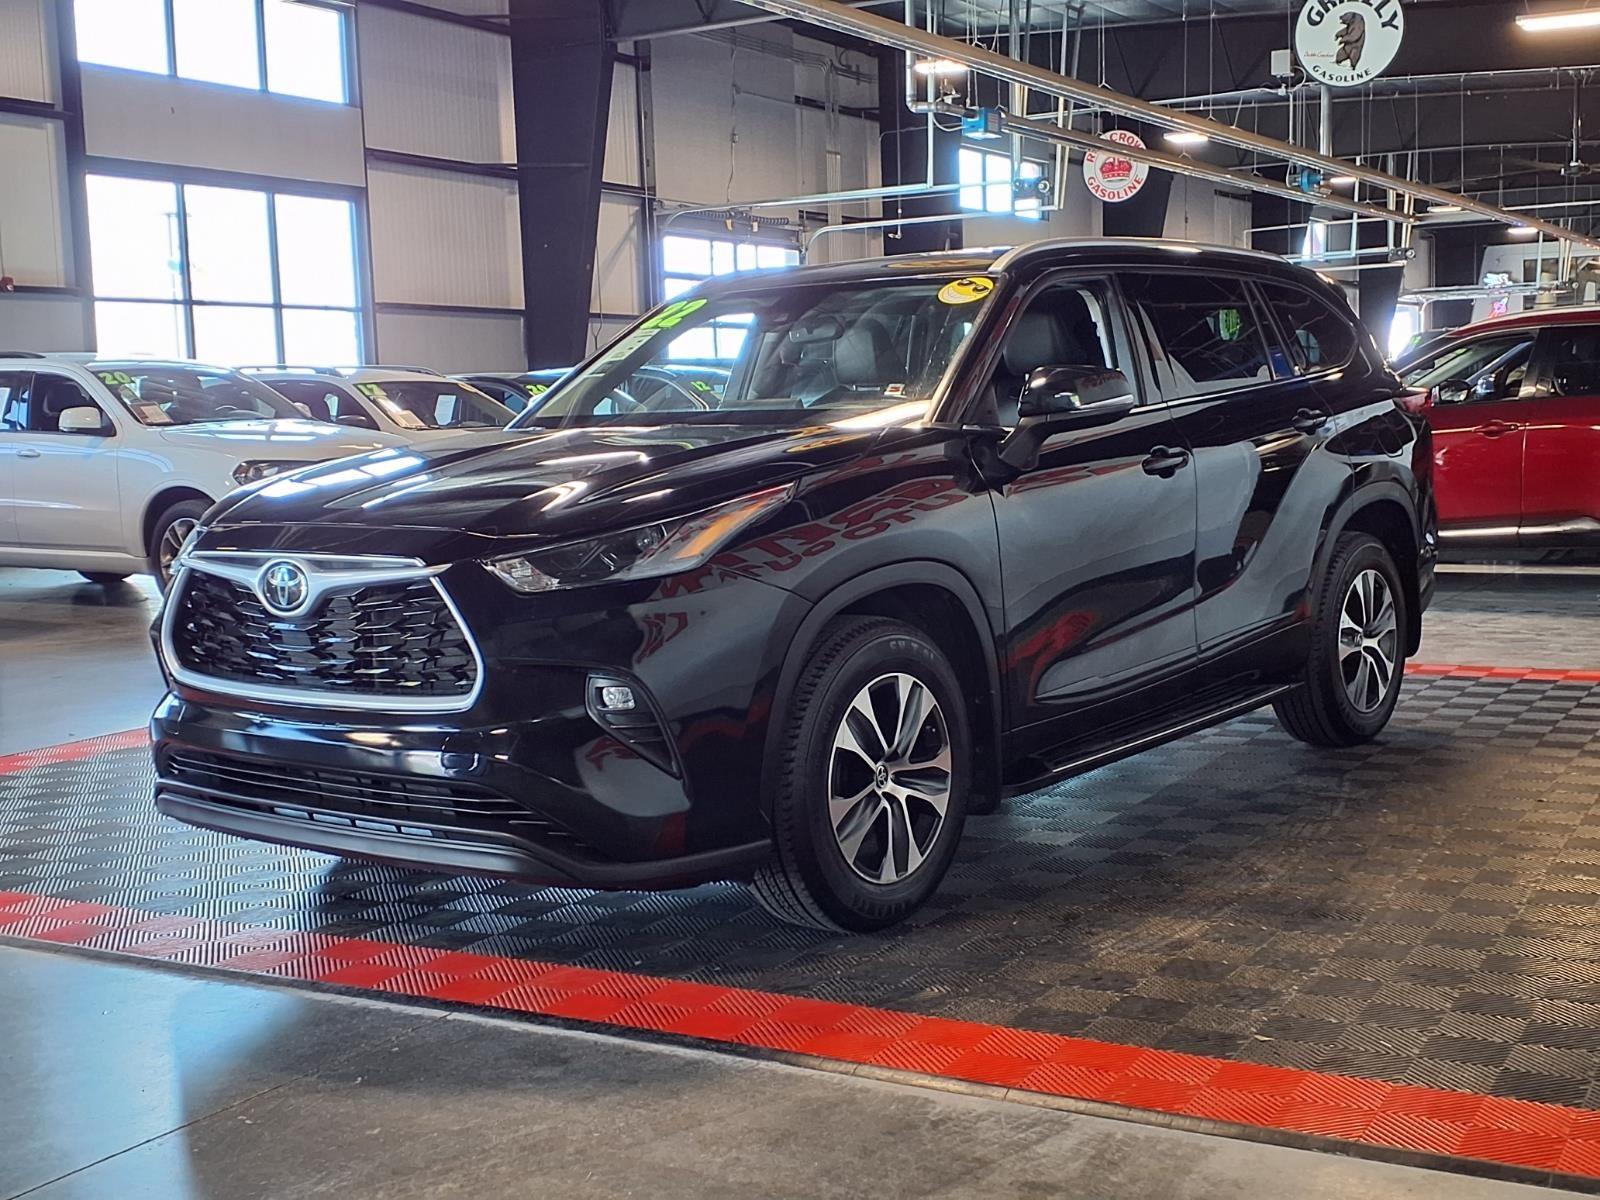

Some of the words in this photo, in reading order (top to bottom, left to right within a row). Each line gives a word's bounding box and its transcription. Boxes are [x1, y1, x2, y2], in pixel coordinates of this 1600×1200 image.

[1312, 65, 1372, 83] GASOLINE
[1087, 175, 1144, 200] GASOLINE
[98, 371, 132, 385] 20
